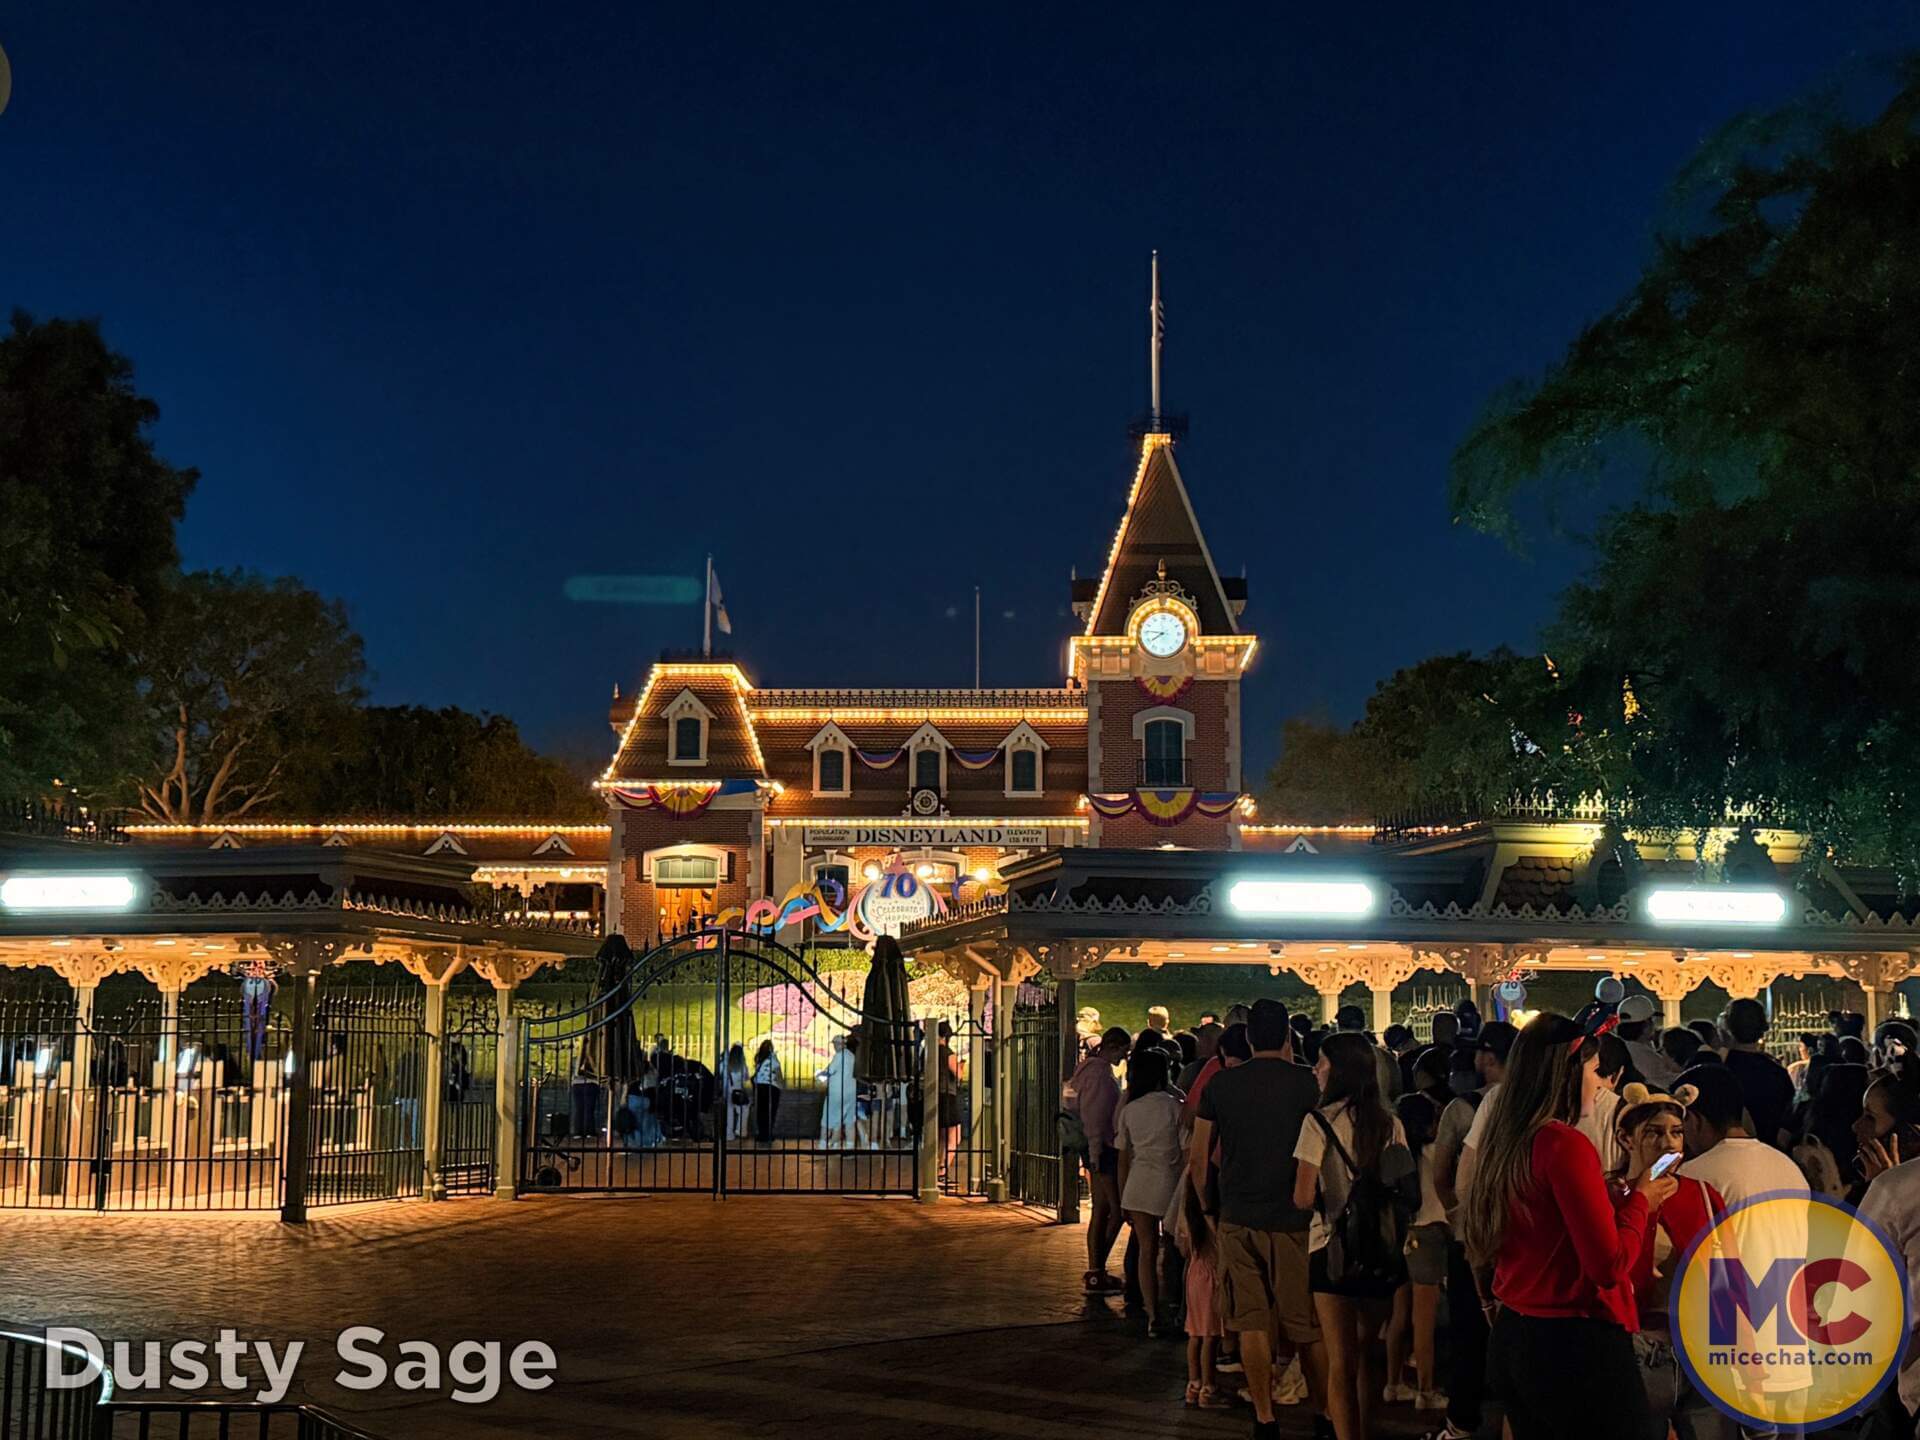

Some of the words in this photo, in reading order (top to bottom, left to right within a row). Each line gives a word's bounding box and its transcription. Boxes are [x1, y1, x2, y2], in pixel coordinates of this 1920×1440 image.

[856, 829, 1002, 843] DISNEYLAND
[881, 873, 918, 898] 70
[1504, 981, 1518, 989] 70
